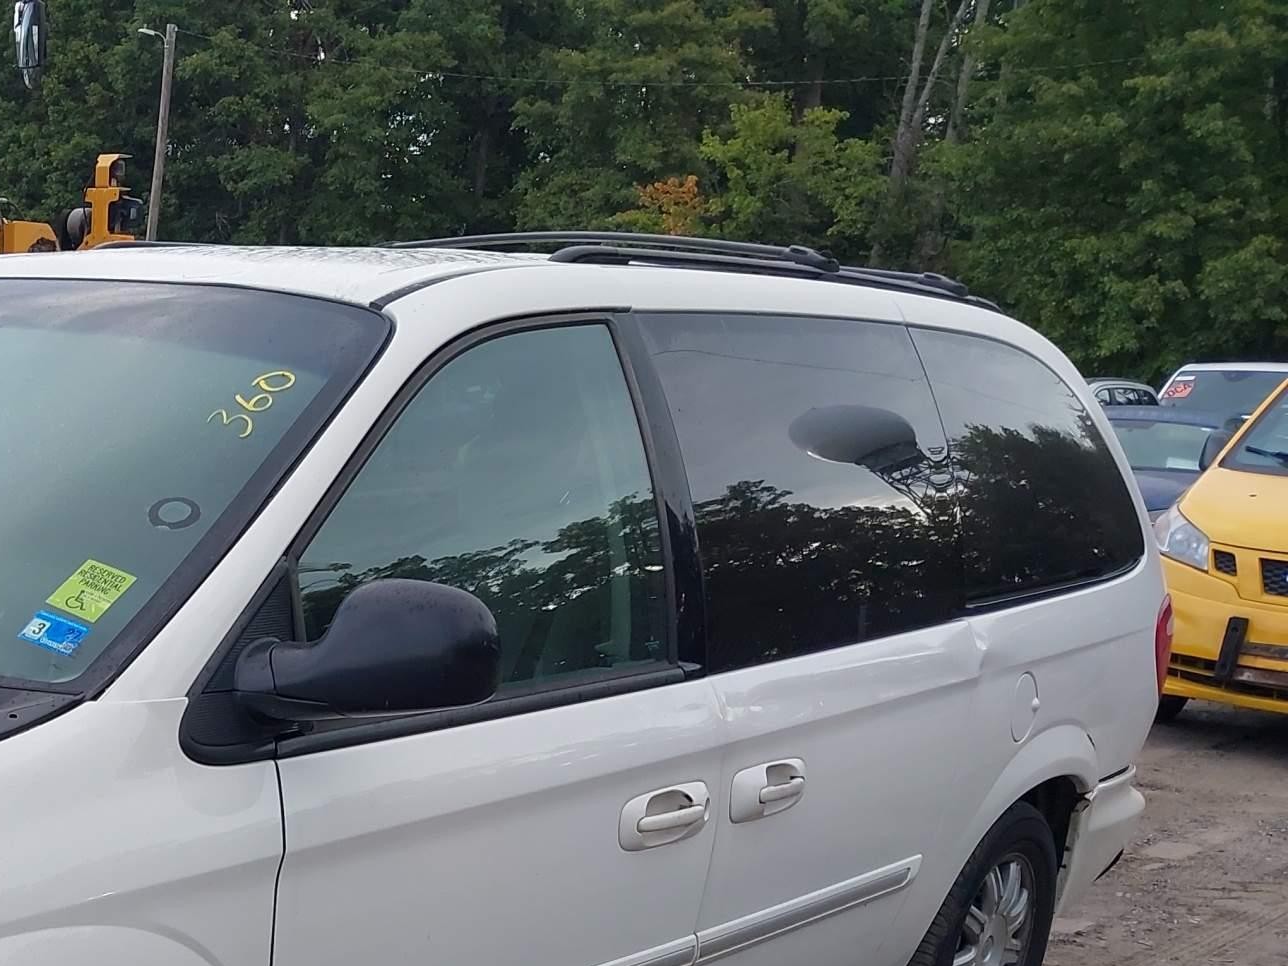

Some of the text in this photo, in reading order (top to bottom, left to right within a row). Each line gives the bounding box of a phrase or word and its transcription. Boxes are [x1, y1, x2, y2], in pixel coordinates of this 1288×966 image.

[207, 371, 296, 437] 360
[78, 569, 123, 592] RESIDENTIAL
[88, 565, 127, 584] RESERVED
[78, 578, 111, 595] PARKING
[32, 622, 46, 635] 3
